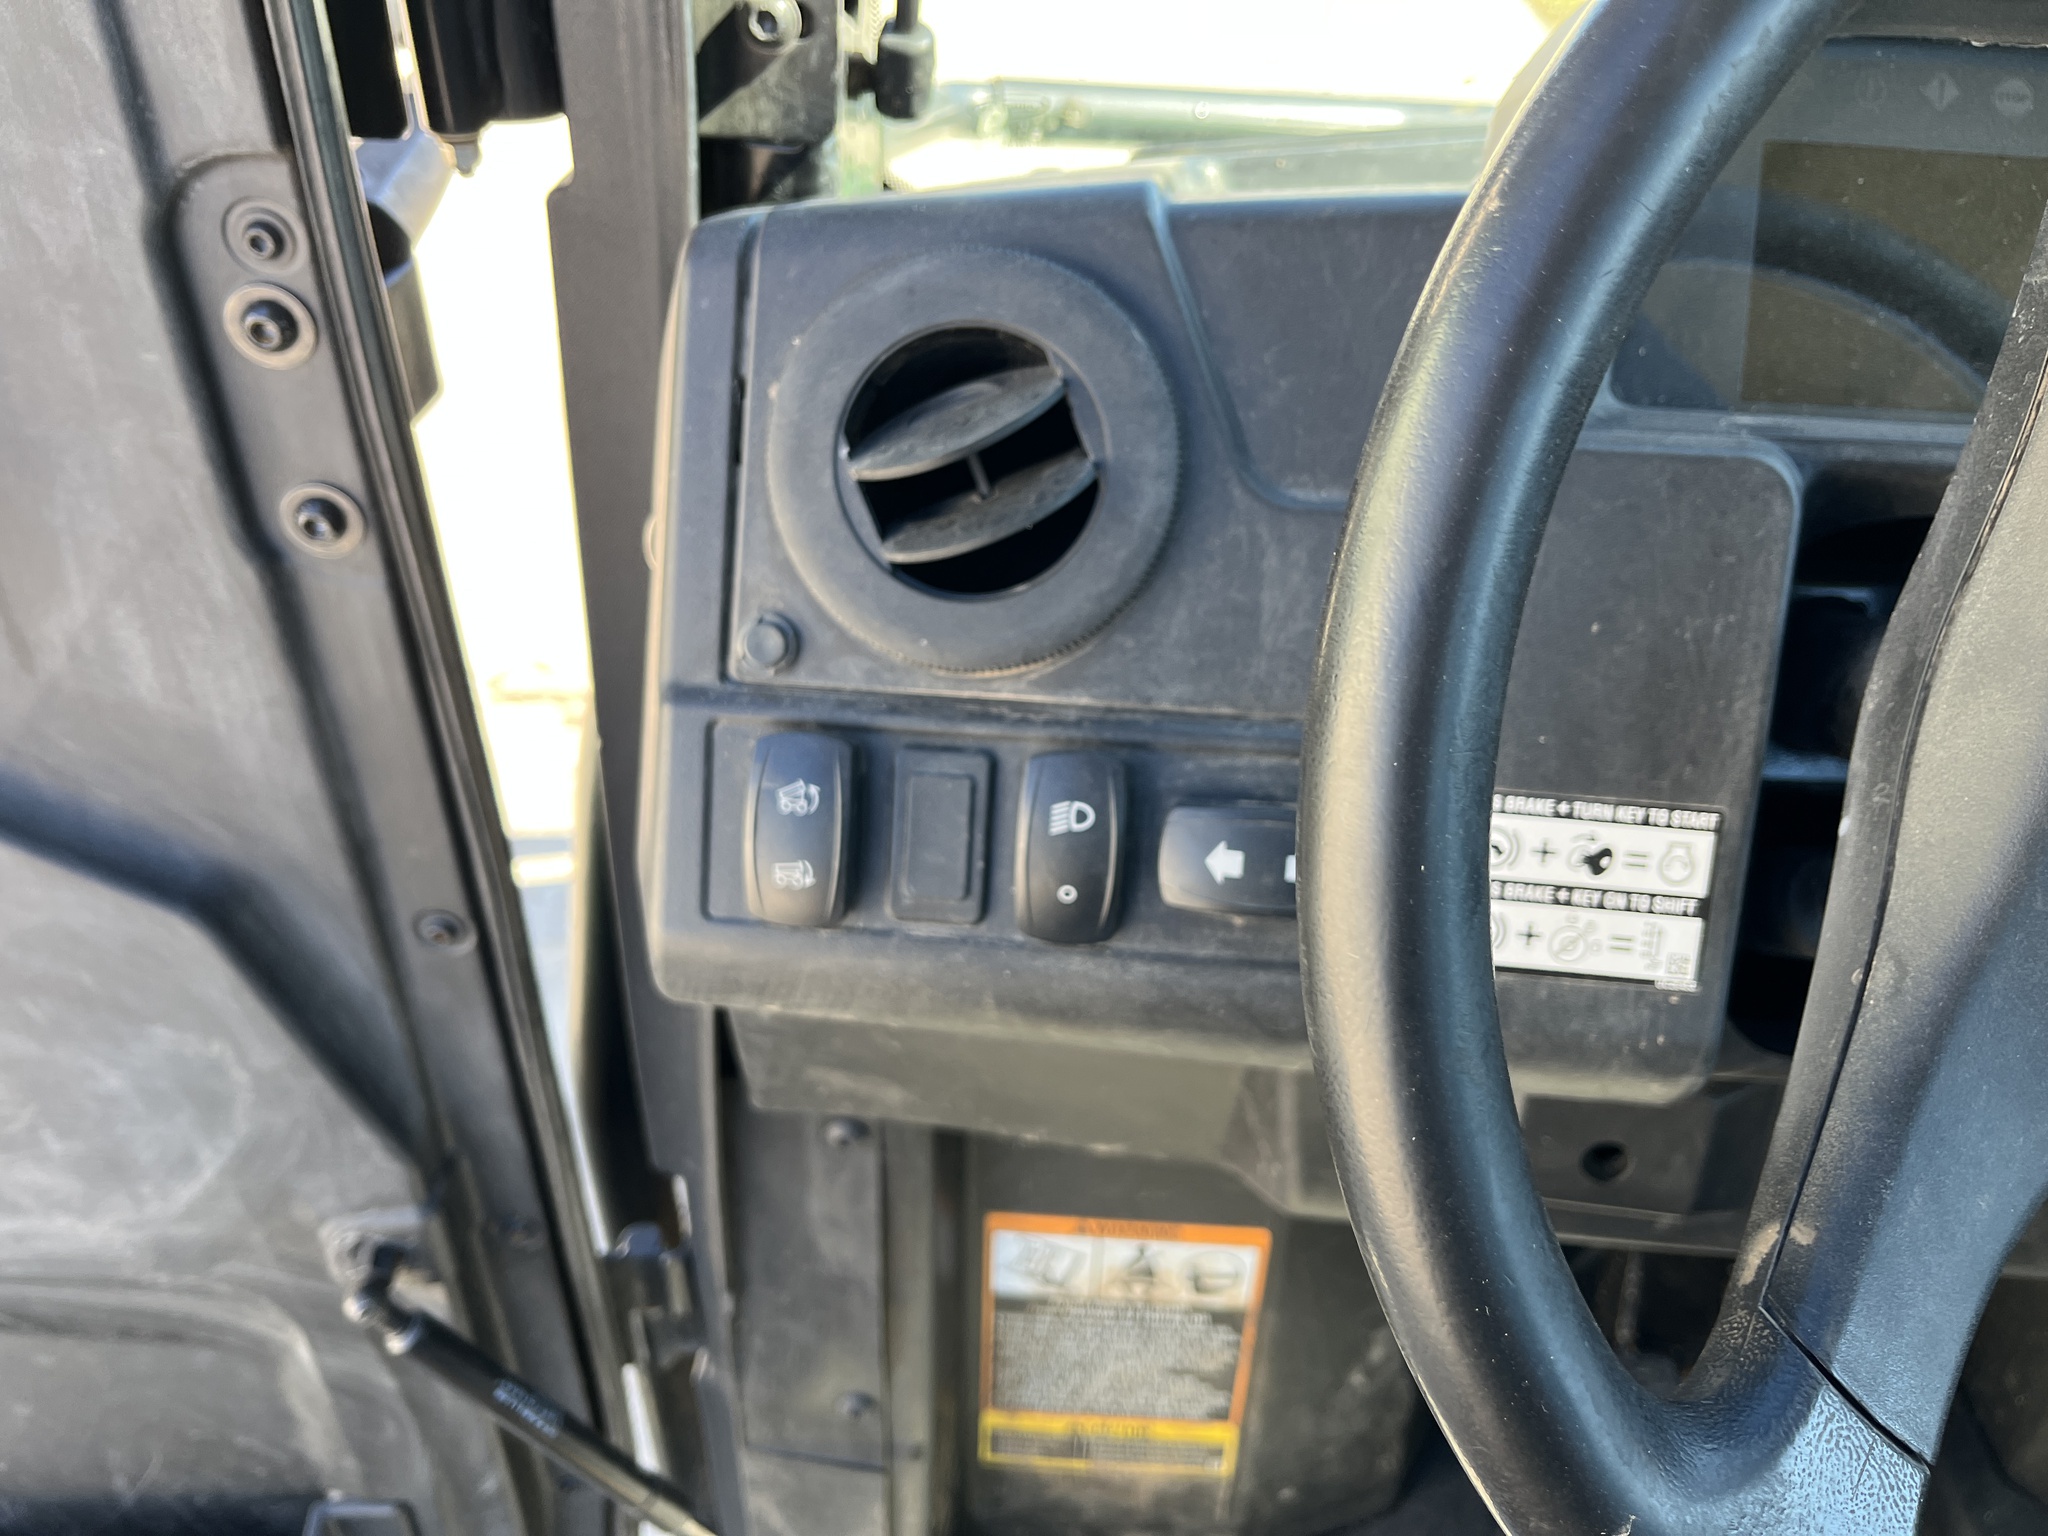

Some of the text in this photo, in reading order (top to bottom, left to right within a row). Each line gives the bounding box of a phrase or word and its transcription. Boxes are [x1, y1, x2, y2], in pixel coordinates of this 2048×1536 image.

[1504, 795, 1556, 817] BRAKE
[1572, 801, 1615, 822] TURN
[1615, 805, 1647, 825] KEY
[1648, 807, 1670, 827] TO
[1670, 809, 1720, 831] START
[1503, 882, 1556, 904] BRAKE
[1571, 888, 1602, 908] KEY
[1603, 890, 1627, 910] ON
[1629, 893, 1650, 912] TO
[1651, 895, 1699, 917] SHIFT
